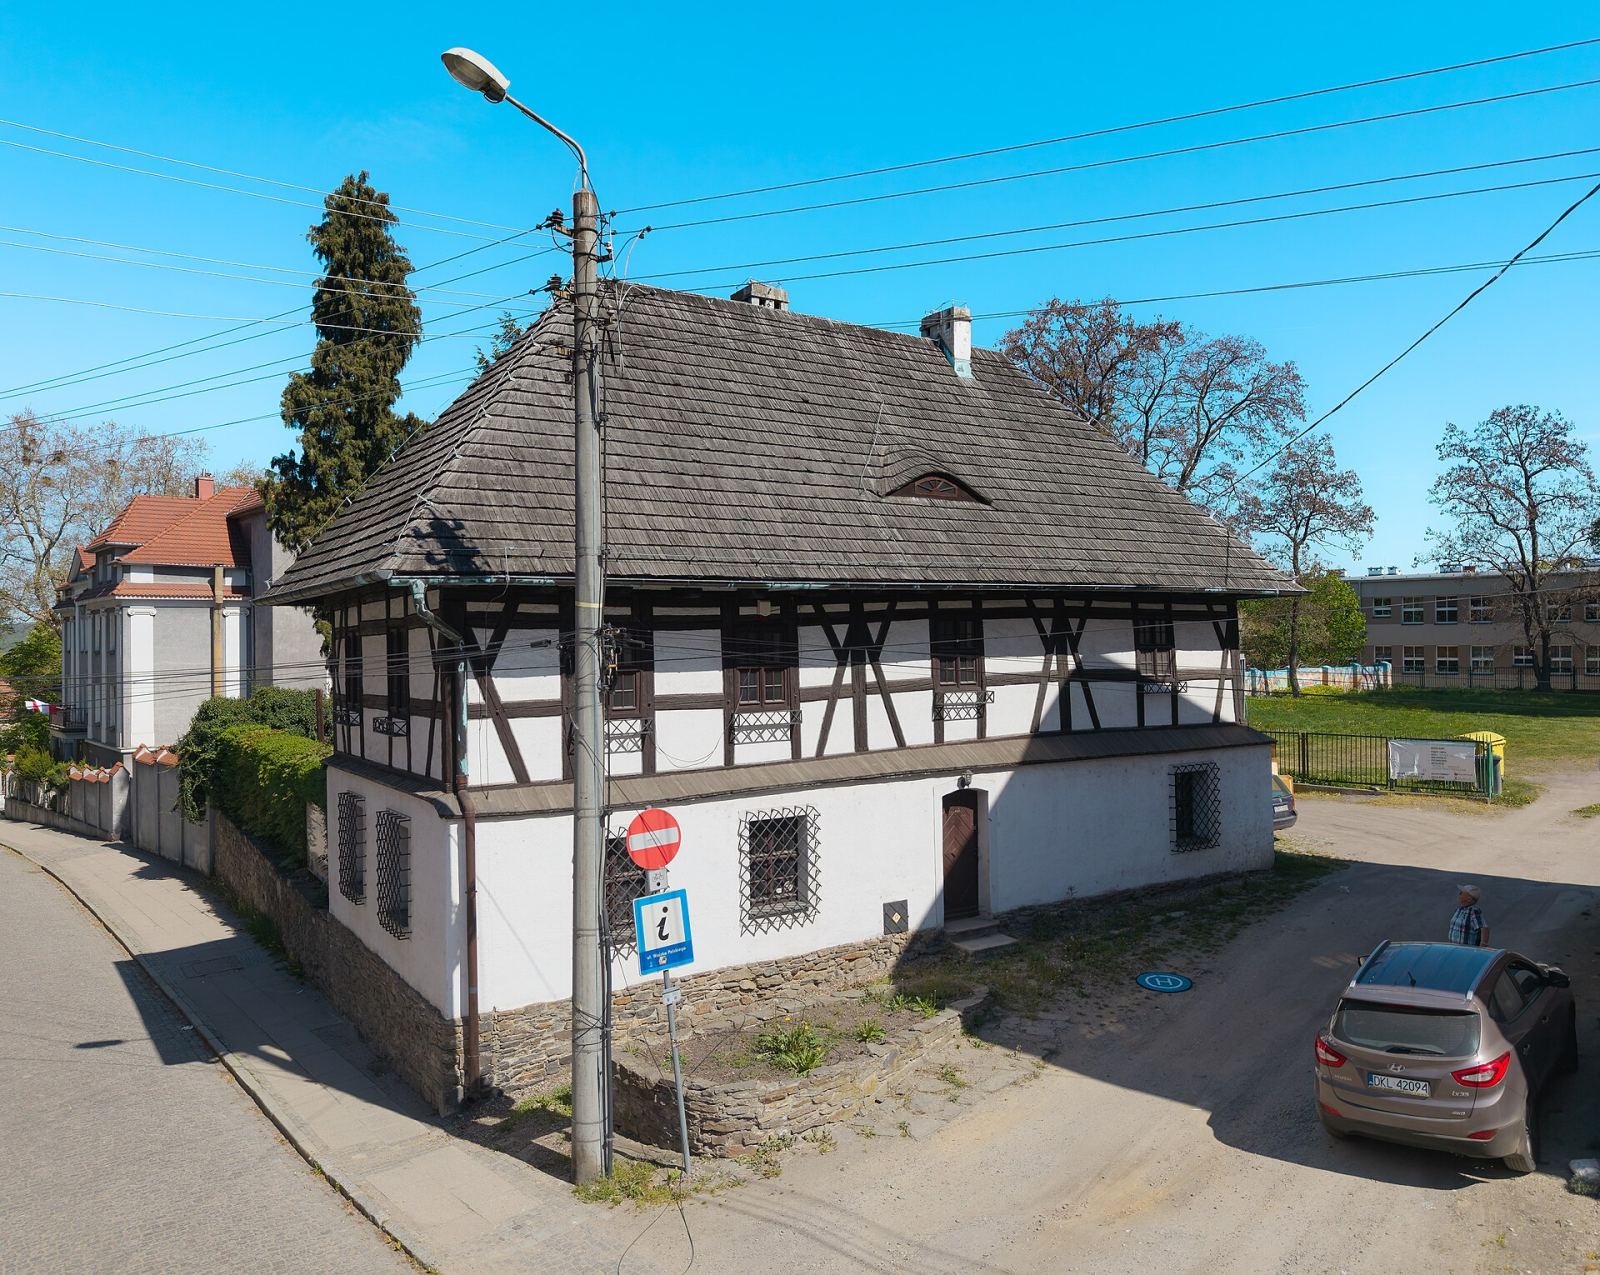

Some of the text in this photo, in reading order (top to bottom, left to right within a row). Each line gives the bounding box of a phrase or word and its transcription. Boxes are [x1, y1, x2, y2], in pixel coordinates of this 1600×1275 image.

[1156, 978, 1173, 986] H
[1373, 1075, 1428, 1094] DKL 42094
